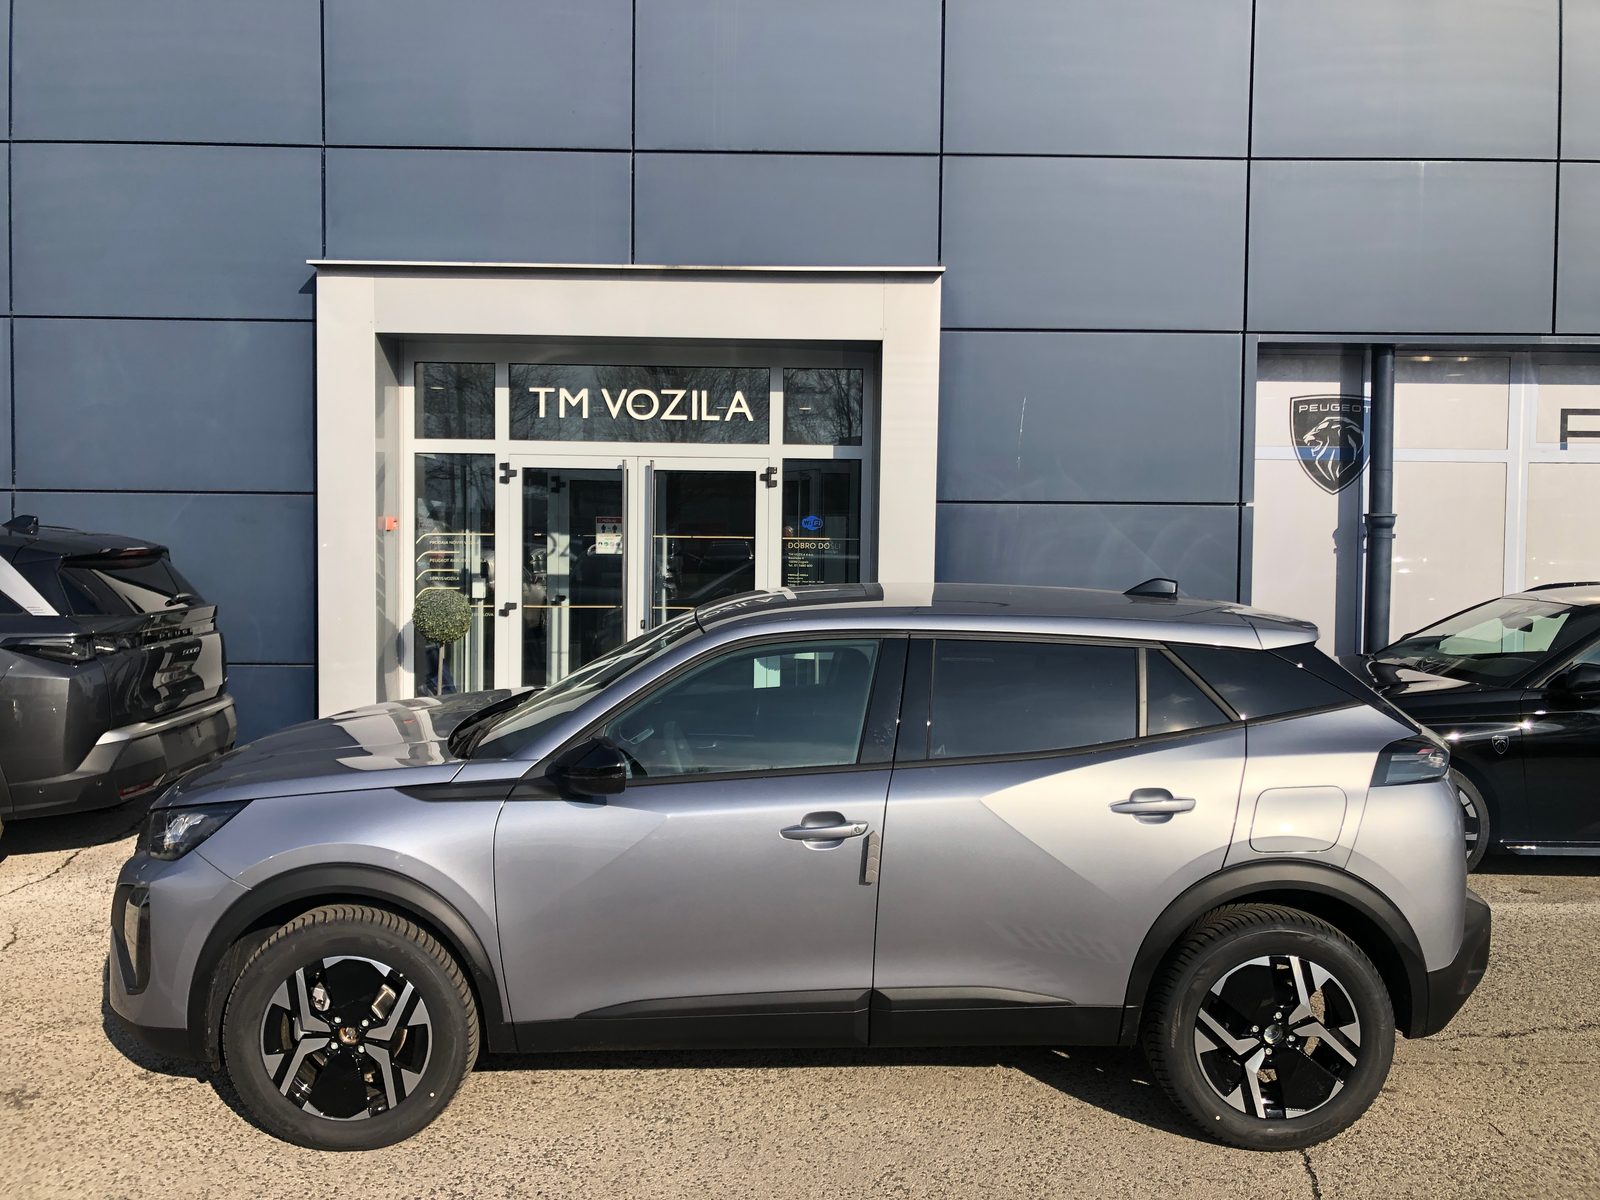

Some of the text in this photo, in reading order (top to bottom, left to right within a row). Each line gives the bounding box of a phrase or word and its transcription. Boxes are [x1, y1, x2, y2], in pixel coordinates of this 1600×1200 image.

[528, 387, 754, 422] TM VOZILA
[1298, 403, 1371, 414] PEUGEOT
